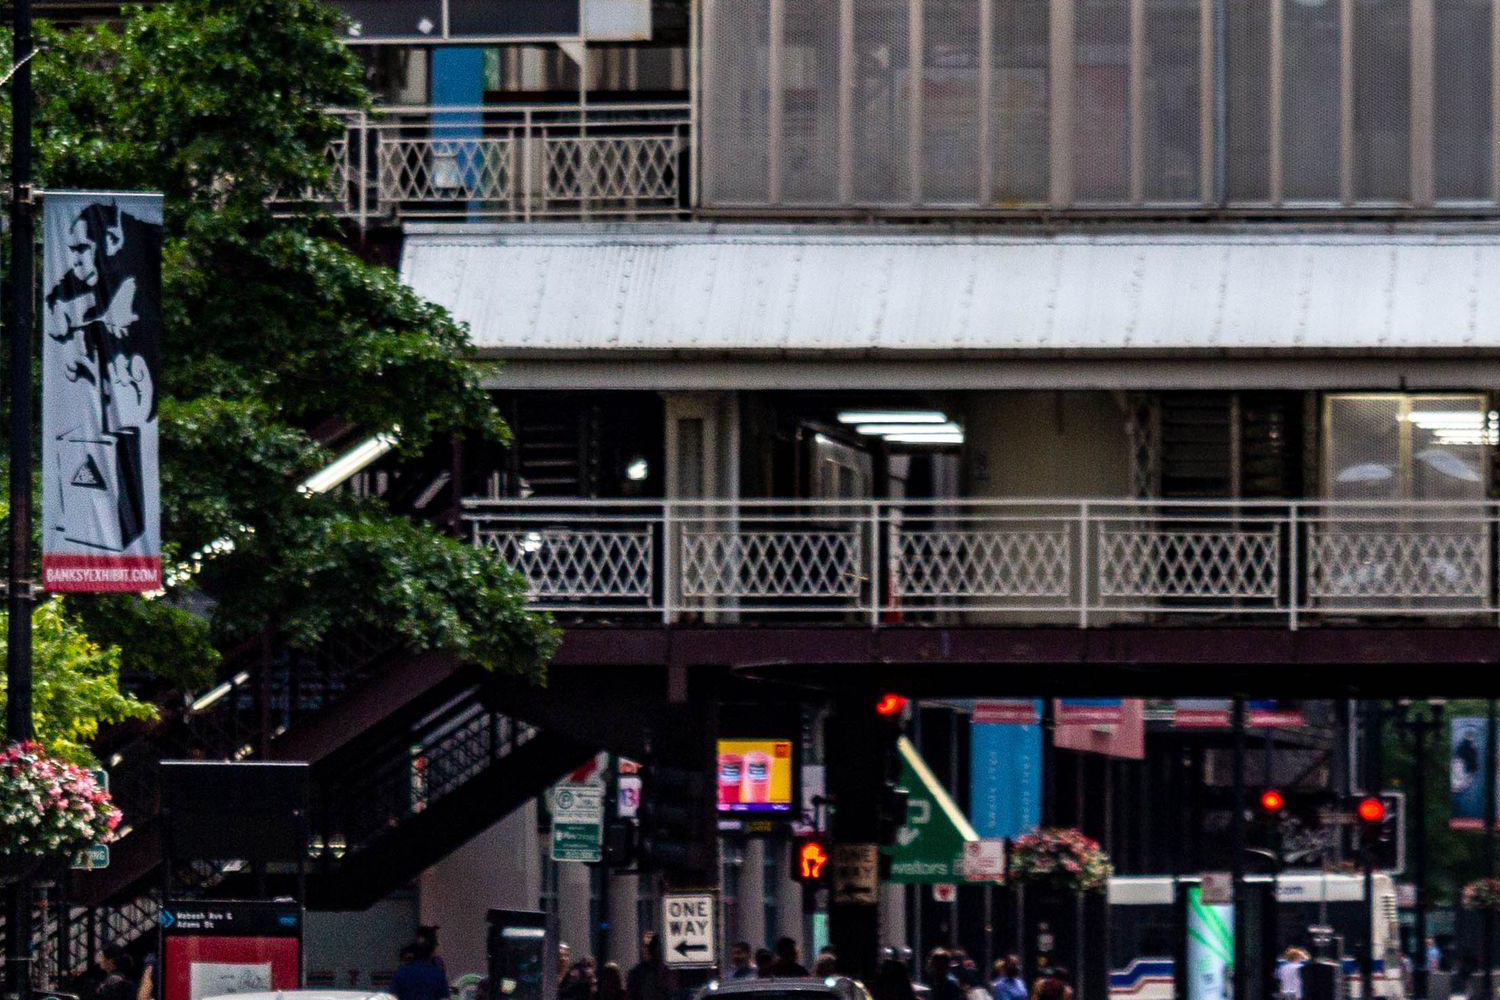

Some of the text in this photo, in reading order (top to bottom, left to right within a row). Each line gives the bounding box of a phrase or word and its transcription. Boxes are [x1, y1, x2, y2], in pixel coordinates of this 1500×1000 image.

[45, 567, 158, 583] BANKSYEXHIBIT.COM
[670, 902, 708, 917] ONE
[669, 920, 709, 936] WAY
